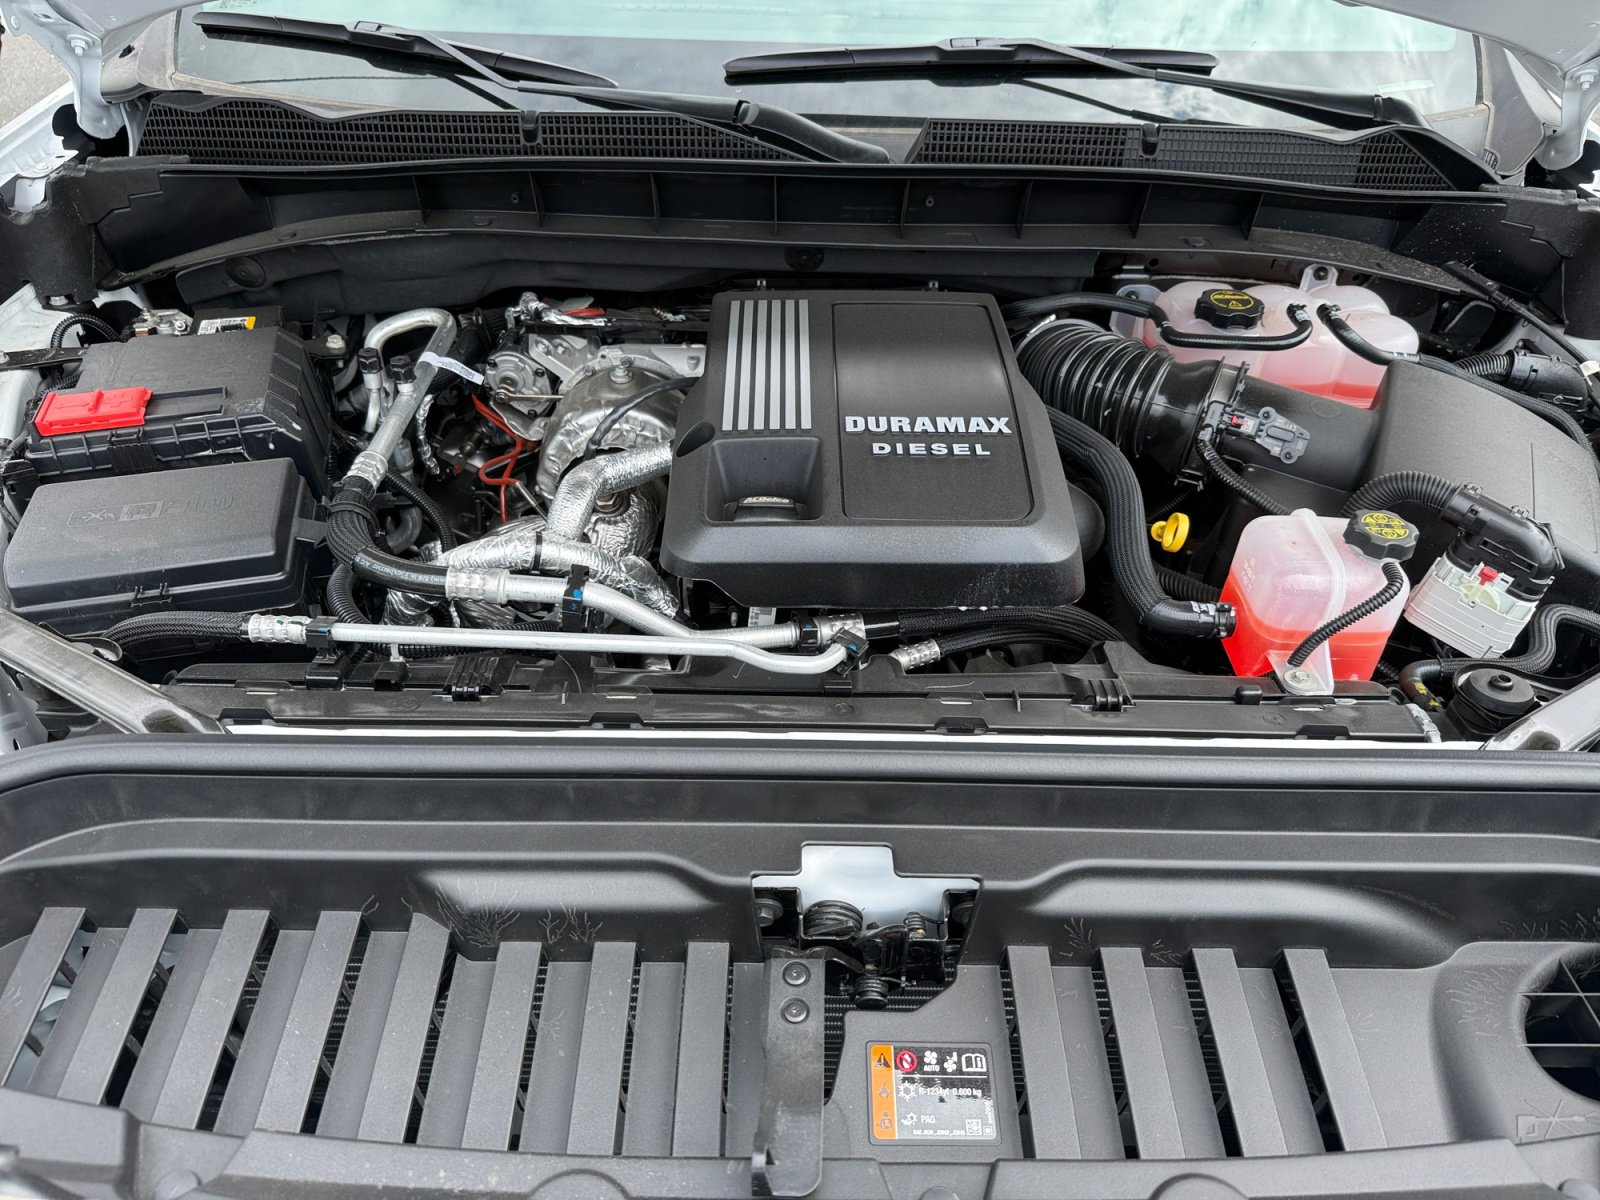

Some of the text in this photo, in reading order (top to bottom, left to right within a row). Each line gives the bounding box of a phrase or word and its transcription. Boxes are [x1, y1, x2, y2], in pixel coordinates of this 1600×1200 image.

[845, 415, 1012, 434] DURAMAX
[872, 442, 991, 456] DIESEL
[952, 1088, 972, 1096] 0.600
[973, 1088, 982, 1097] kg
[920, 1115, 936, 1123] PAG
